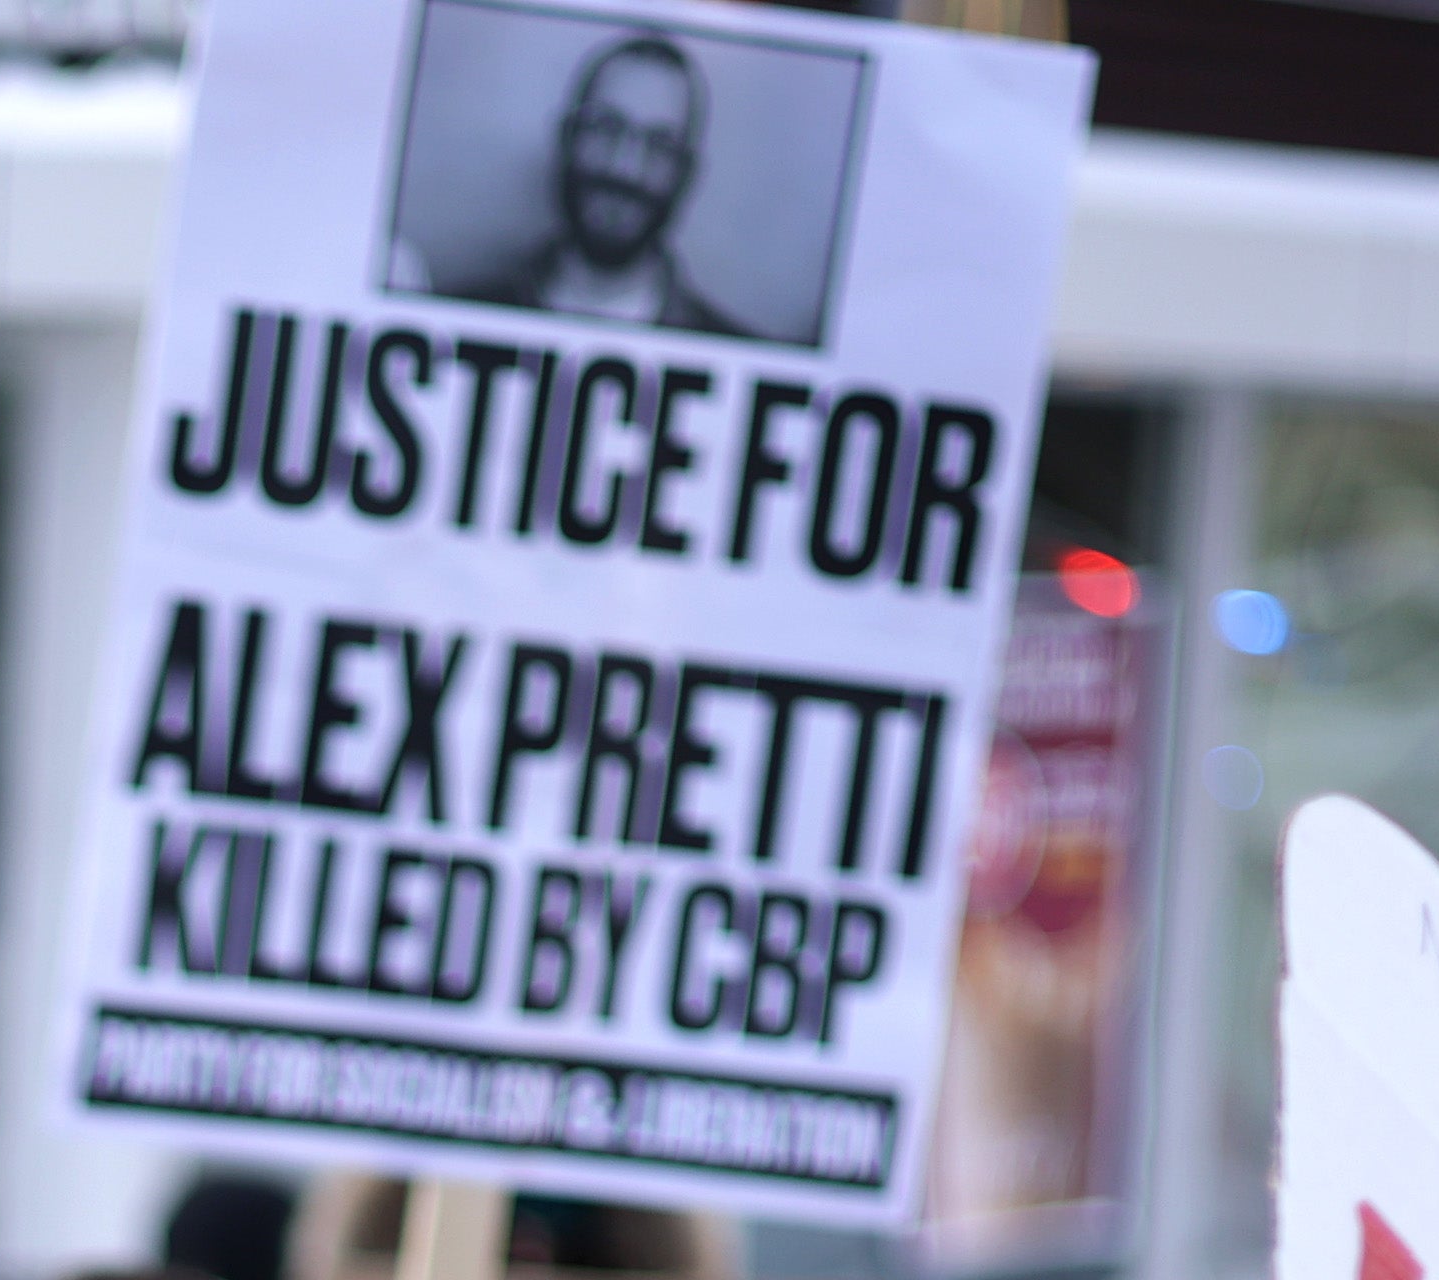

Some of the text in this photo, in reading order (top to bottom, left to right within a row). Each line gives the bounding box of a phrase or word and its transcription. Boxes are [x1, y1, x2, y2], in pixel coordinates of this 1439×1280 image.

[166, 306, 998, 592] JUSTICE FOR
[133, 598, 471, 825] ALEX
[486, 636, 949, 880] PRETTI
[136, 822, 889, 1054] KILLED BY CBP
